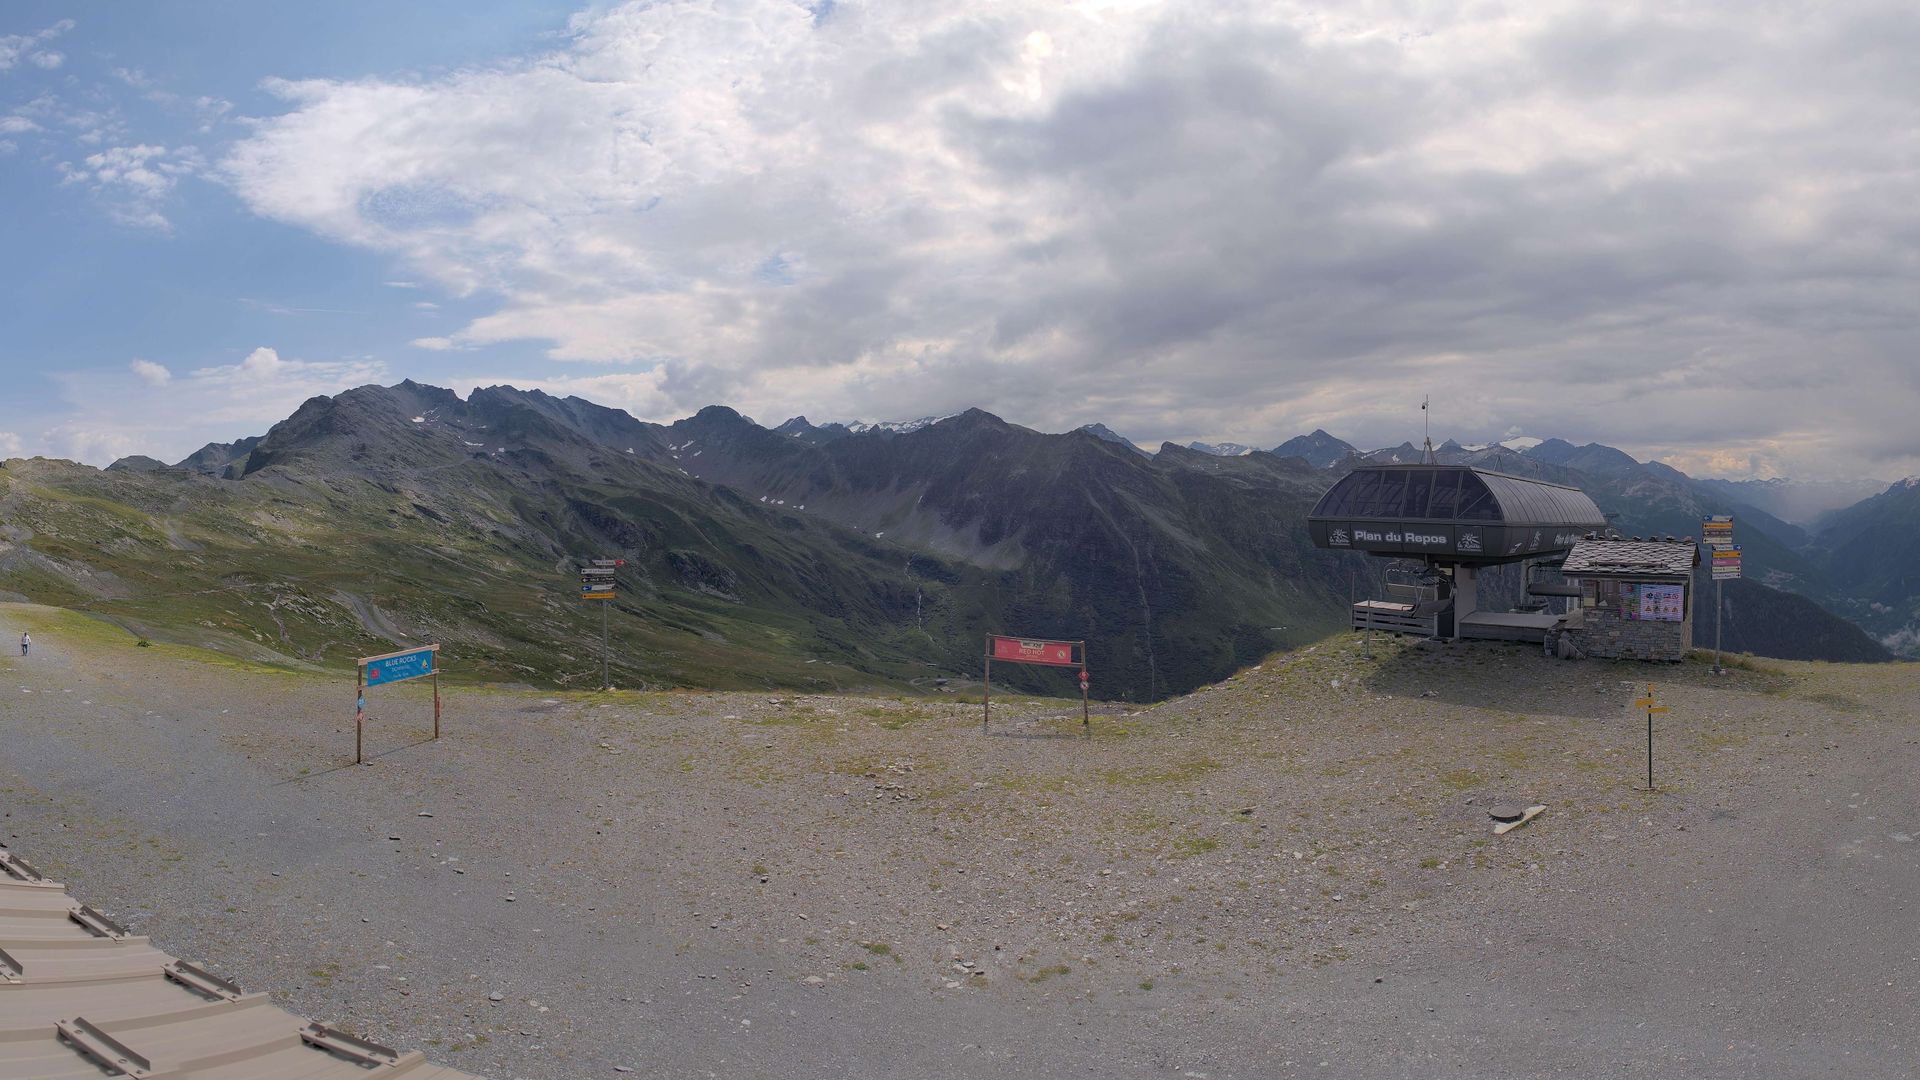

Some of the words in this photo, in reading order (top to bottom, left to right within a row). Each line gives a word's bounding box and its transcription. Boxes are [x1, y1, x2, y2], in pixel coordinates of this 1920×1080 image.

[1354, 531, 1382, 541] Plan
[1386, 532, 1401, 542] du
[1405, 533, 1447, 546] Repos
[385, 659, 399, 667] BLUE
[399, 655, 417, 664] ROCKS
